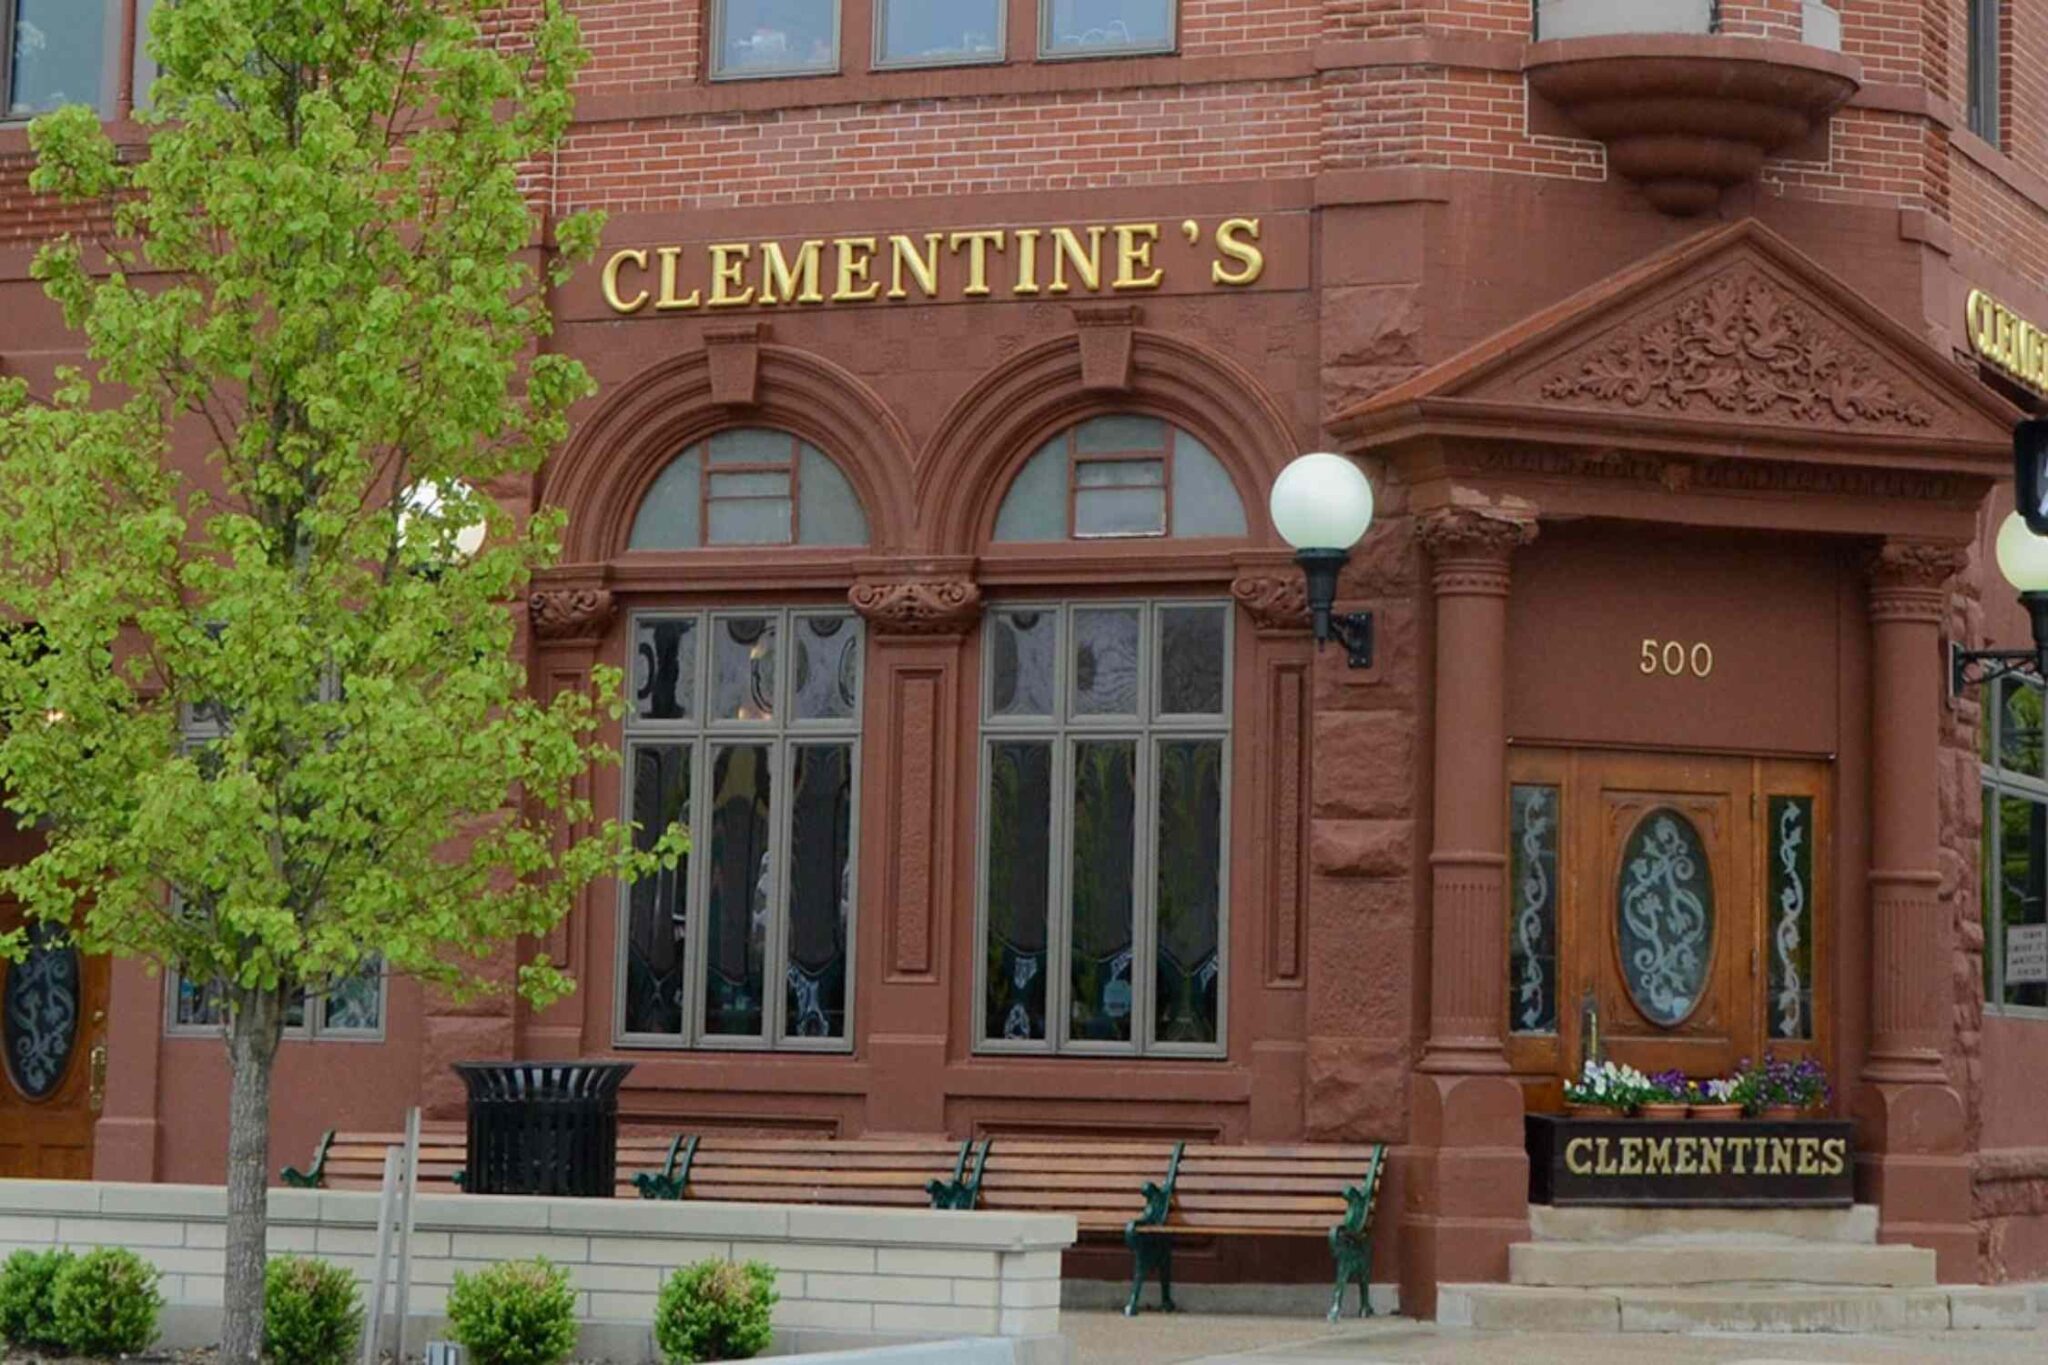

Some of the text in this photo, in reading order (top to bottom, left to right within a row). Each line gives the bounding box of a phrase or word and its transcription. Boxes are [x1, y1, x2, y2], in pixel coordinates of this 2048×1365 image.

[602, 218, 1263, 313] CLEMENTINE'S
[1640, 639, 1712, 677] 500
[1566, 1137, 1846, 1175] CLEMENTINES
